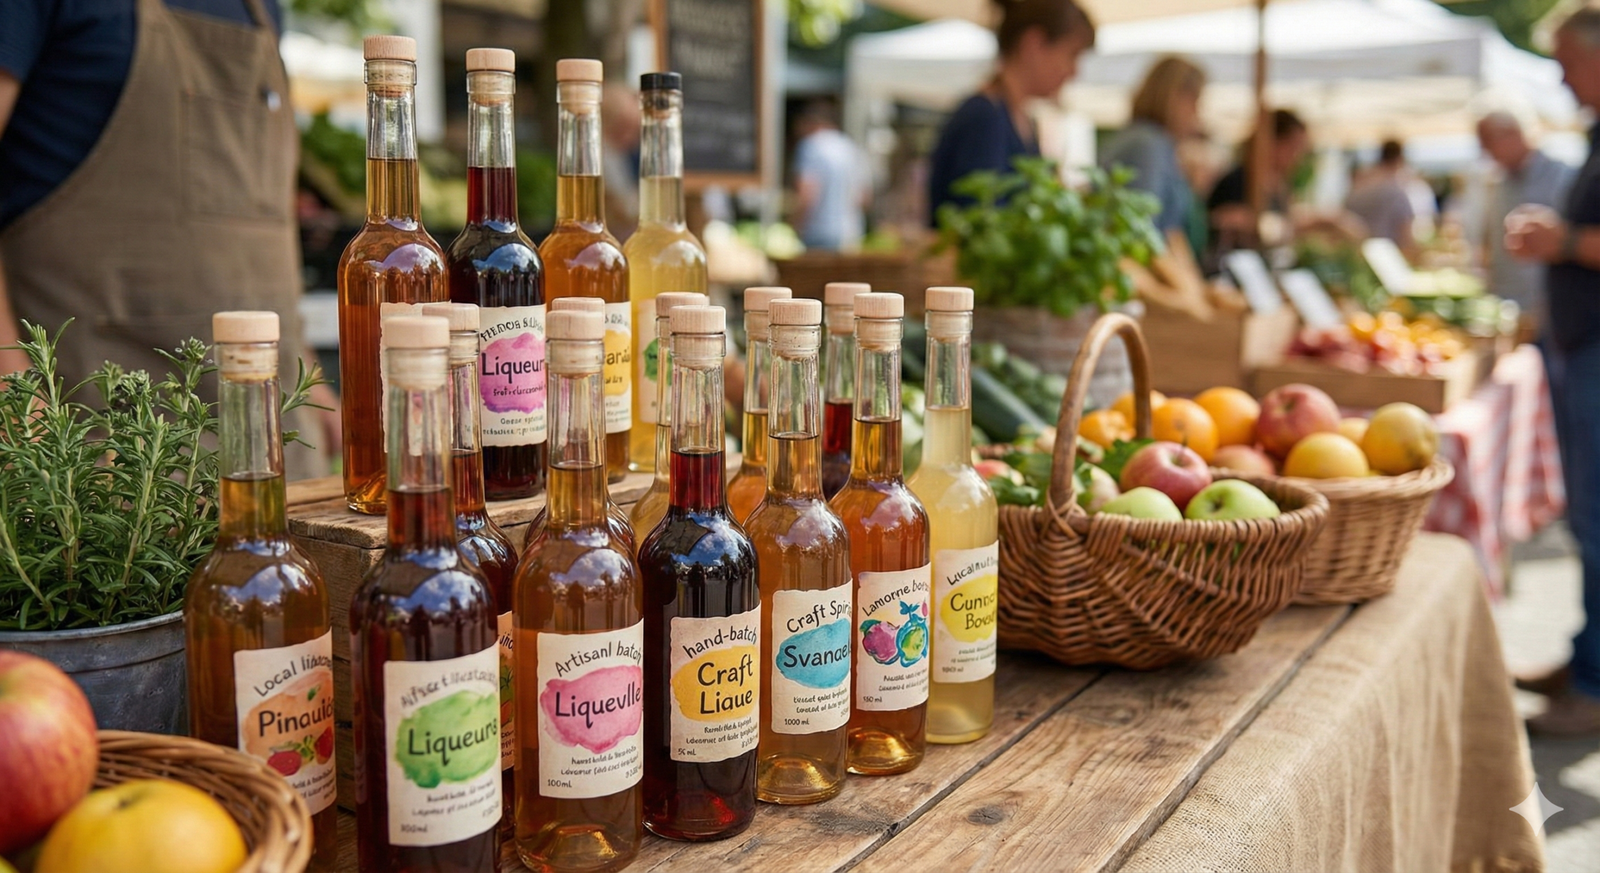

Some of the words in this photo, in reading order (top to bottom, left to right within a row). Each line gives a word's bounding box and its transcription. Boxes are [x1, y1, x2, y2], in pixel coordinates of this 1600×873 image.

[786, 604, 826, 634] Craft
[253, 660, 298, 698] Local
[697, 653, 754, 687] Craft
[699, 689, 753, 715] Liaue
